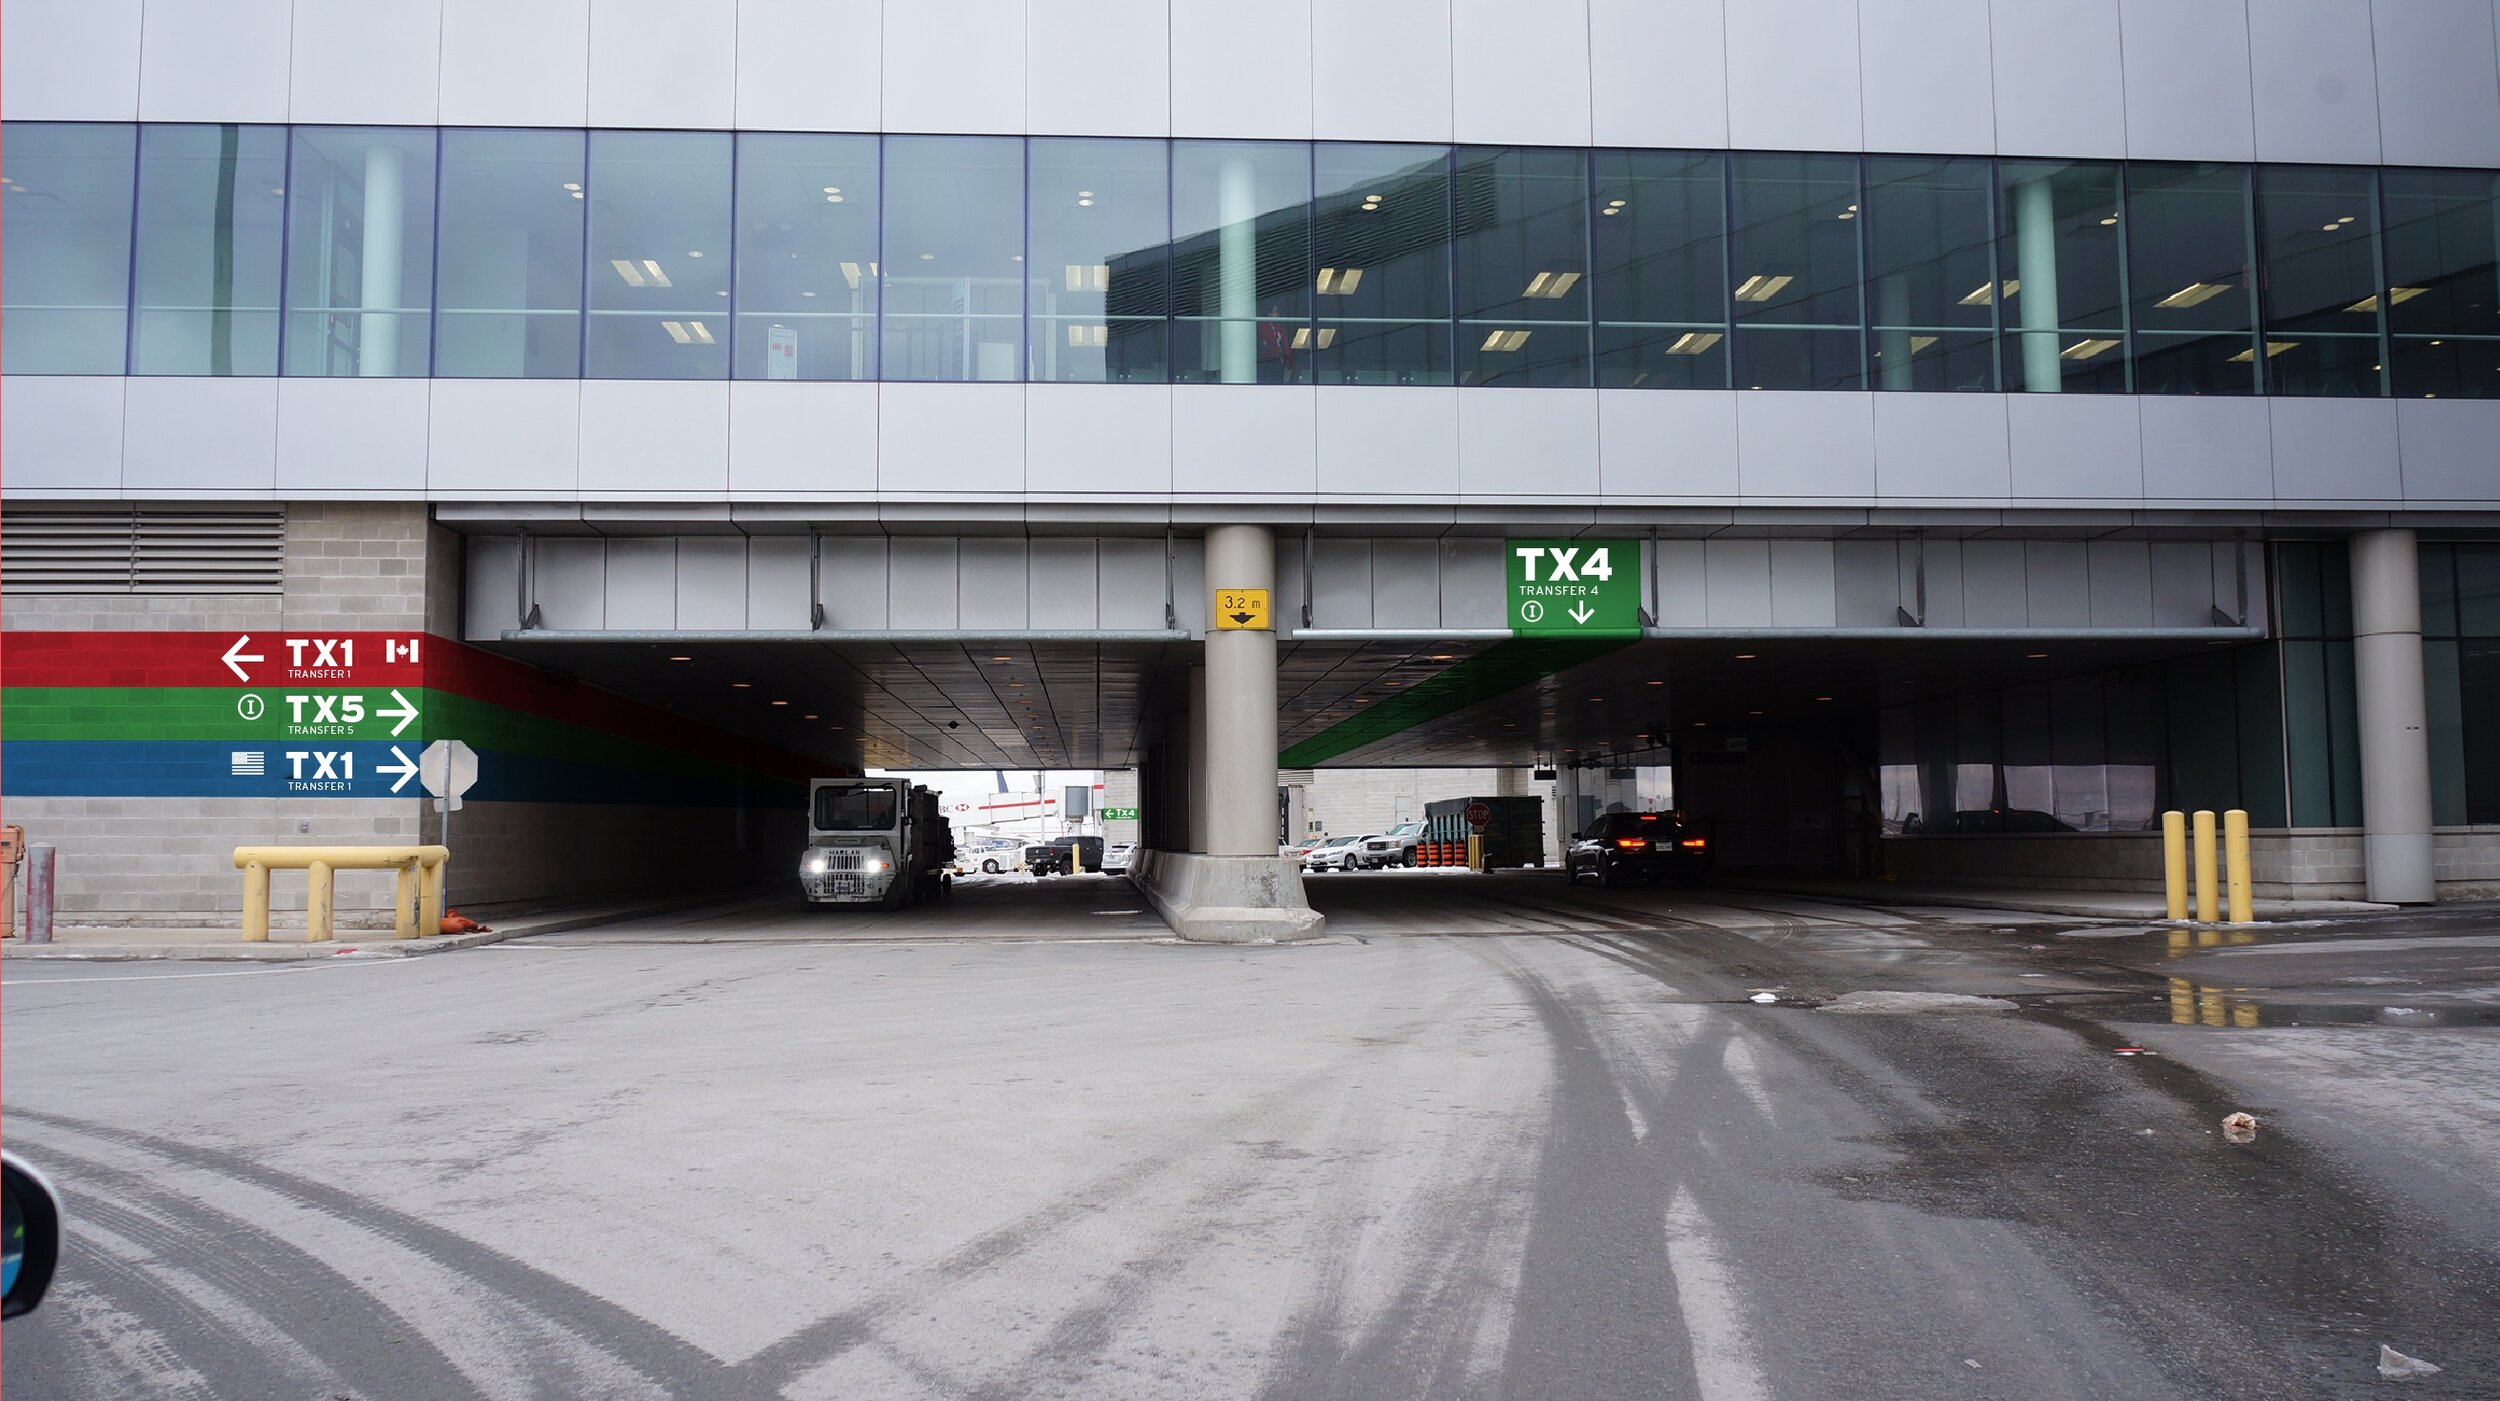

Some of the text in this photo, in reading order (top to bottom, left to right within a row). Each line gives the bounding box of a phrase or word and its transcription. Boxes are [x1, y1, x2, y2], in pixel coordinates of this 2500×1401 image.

[1516, 547, 1613, 582] TX4
[1519, 585, 1599, 596] TRANSFER 4
[1225, 595, 1261, 609] 3.2 m
[285, 639, 353, 667] TX1
[288, 669, 351, 679] TRANSFER 1
[285, 695, 365, 723] TX5
[288, 725, 354, 735] TRANSFER 5
[285, 751, 353, 779] TX1
[288, 781, 351, 791] TRANSFER 1
[1468, 810, 1489, 820] STOP
